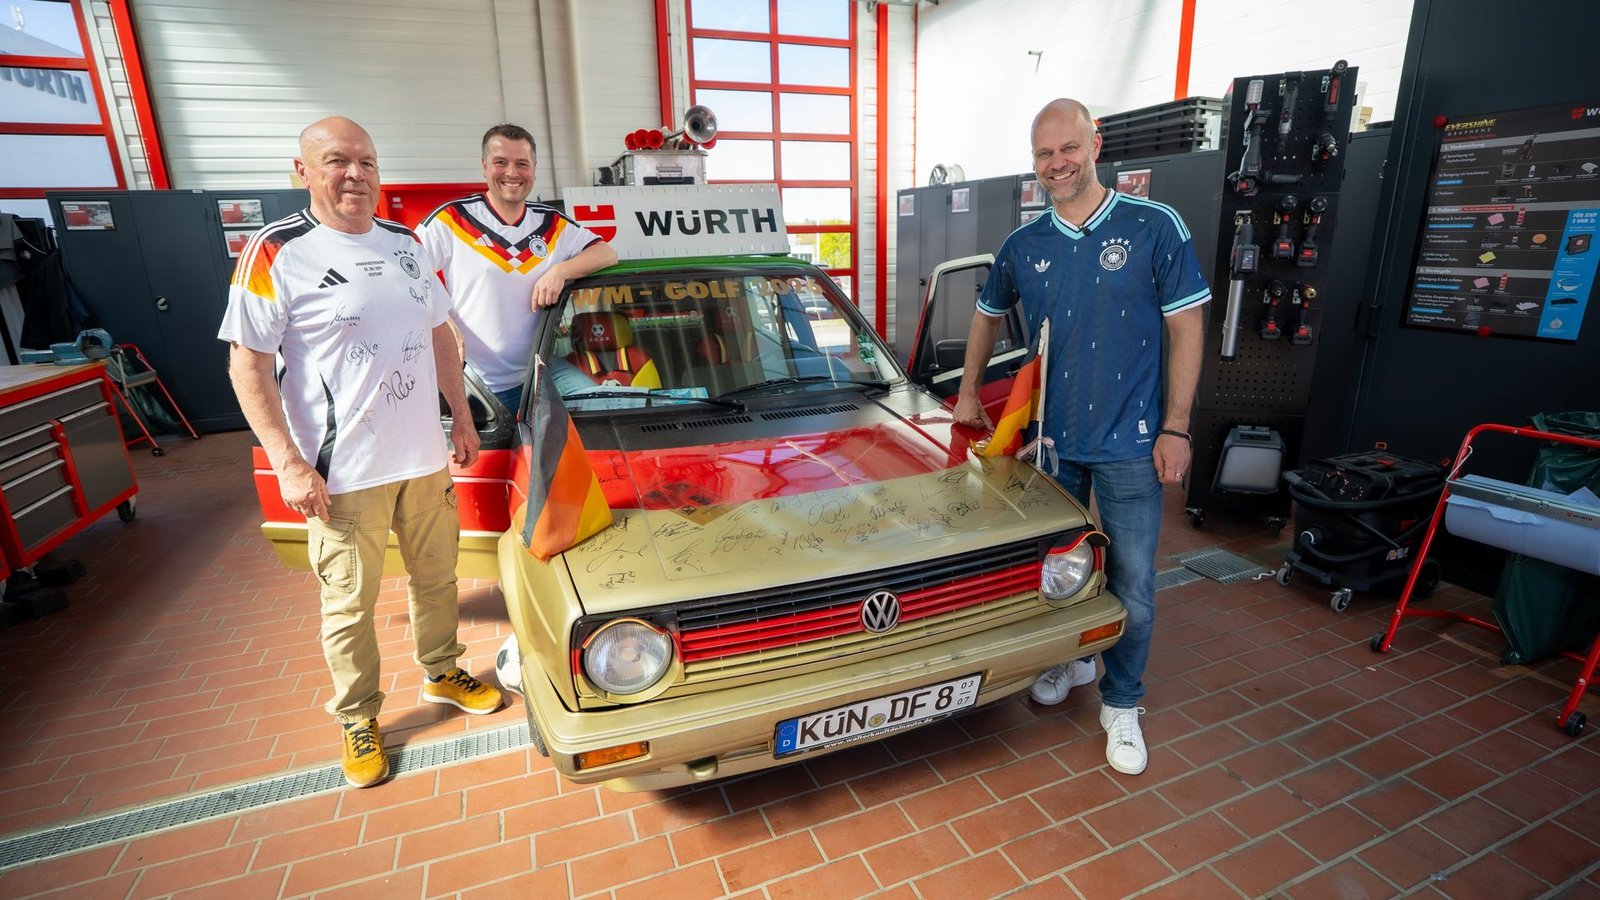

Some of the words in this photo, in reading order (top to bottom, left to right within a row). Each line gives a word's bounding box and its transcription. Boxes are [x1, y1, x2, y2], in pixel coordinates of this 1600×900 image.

[1444, 118, 1497, 132] EVERSHINE
[1447, 128, 1492, 137] GRAPHENE
[635, 208, 778, 237] WÜRTH
[573, 285, 634, 307] WM
[664, 280, 740, 300] GOLF
[961, 680, 974, 689] 03
[956, 696, 970, 706] 07
[782, 739, 790, 747] D
[799, 706, 868, 744] KÜN
[887, 690, 932, 723] DF
[934, 685, 954, 710] 8
